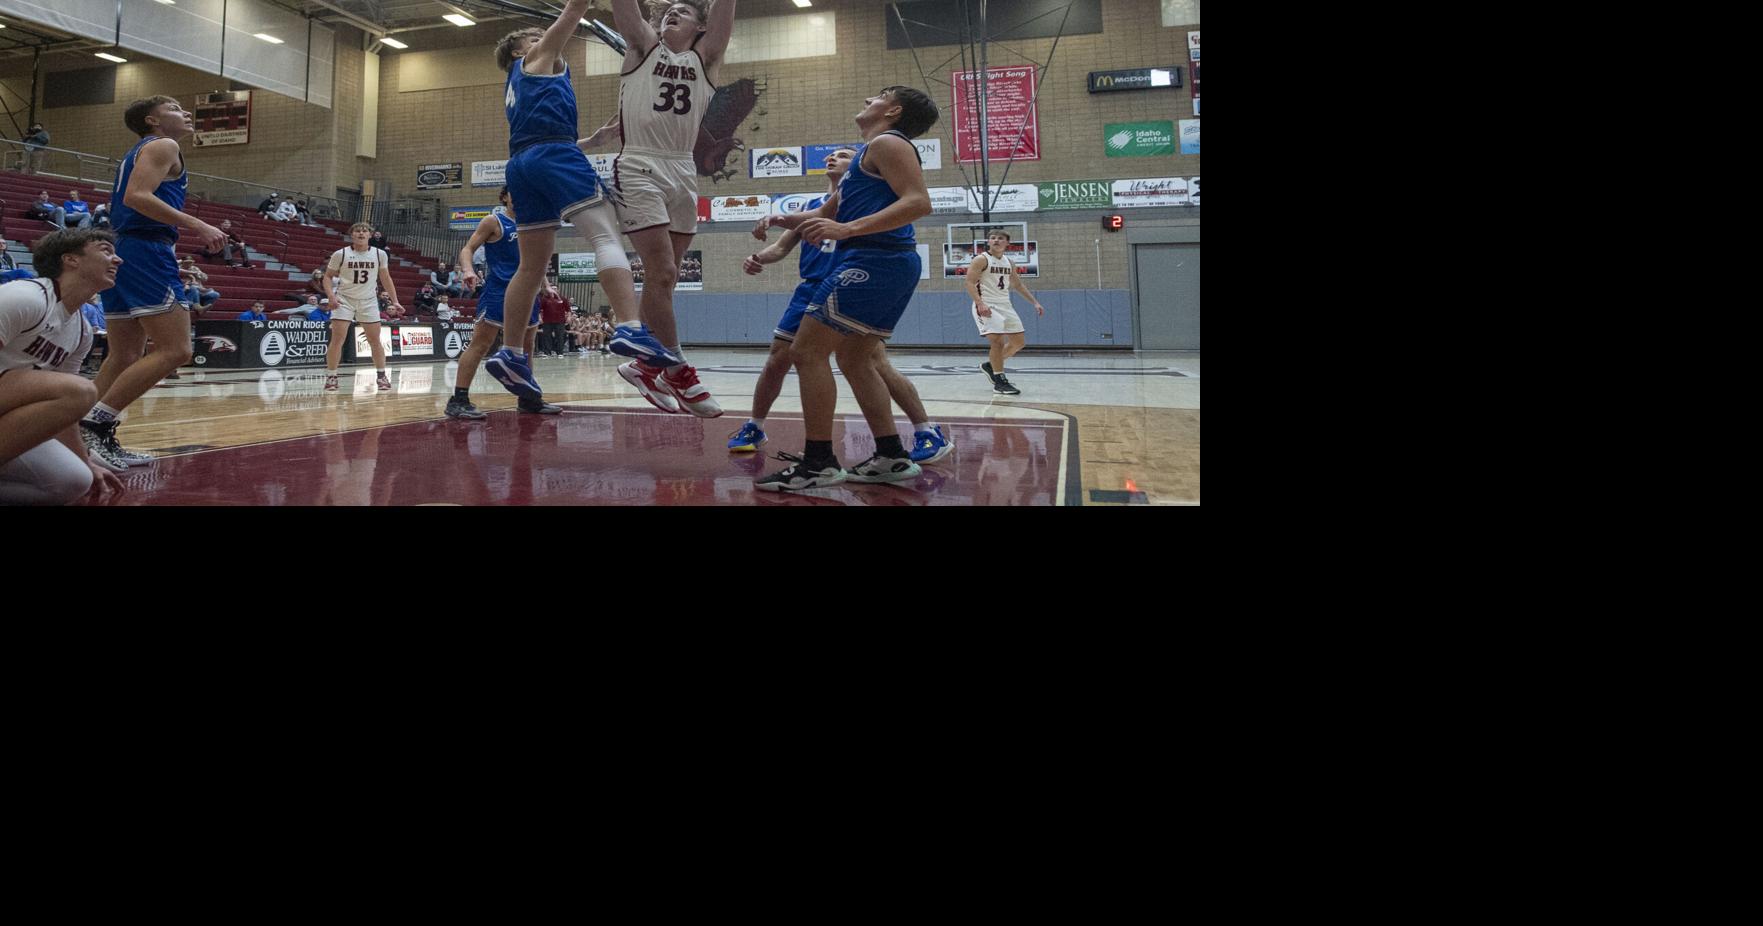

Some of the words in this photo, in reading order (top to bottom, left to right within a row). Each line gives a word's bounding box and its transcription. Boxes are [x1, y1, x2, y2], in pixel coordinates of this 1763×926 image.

[652, 62, 696, 81] HAWKS
[1006, 71, 1026, 79] Song
[653, 82, 692, 115] 33
[1136, 136, 1171, 144] Central
[1129, 180, 1173, 192] Wright
[1054, 182, 1110, 203] JENSEN
[1112, 215, 1122, 228] 2
[347, 261, 375, 269] HAWKS
[990, 266, 1011, 274] HAWKS
[353, 270, 369, 284] 13
[997, 275, 1005, 290] 4
[268, 321, 301, 329] CANYON
[286, 331, 329, 343] WADDELL
[411, 336, 433, 345] GUARD
[285, 344, 306, 357] &
[306, 344, 328, 356] REED
